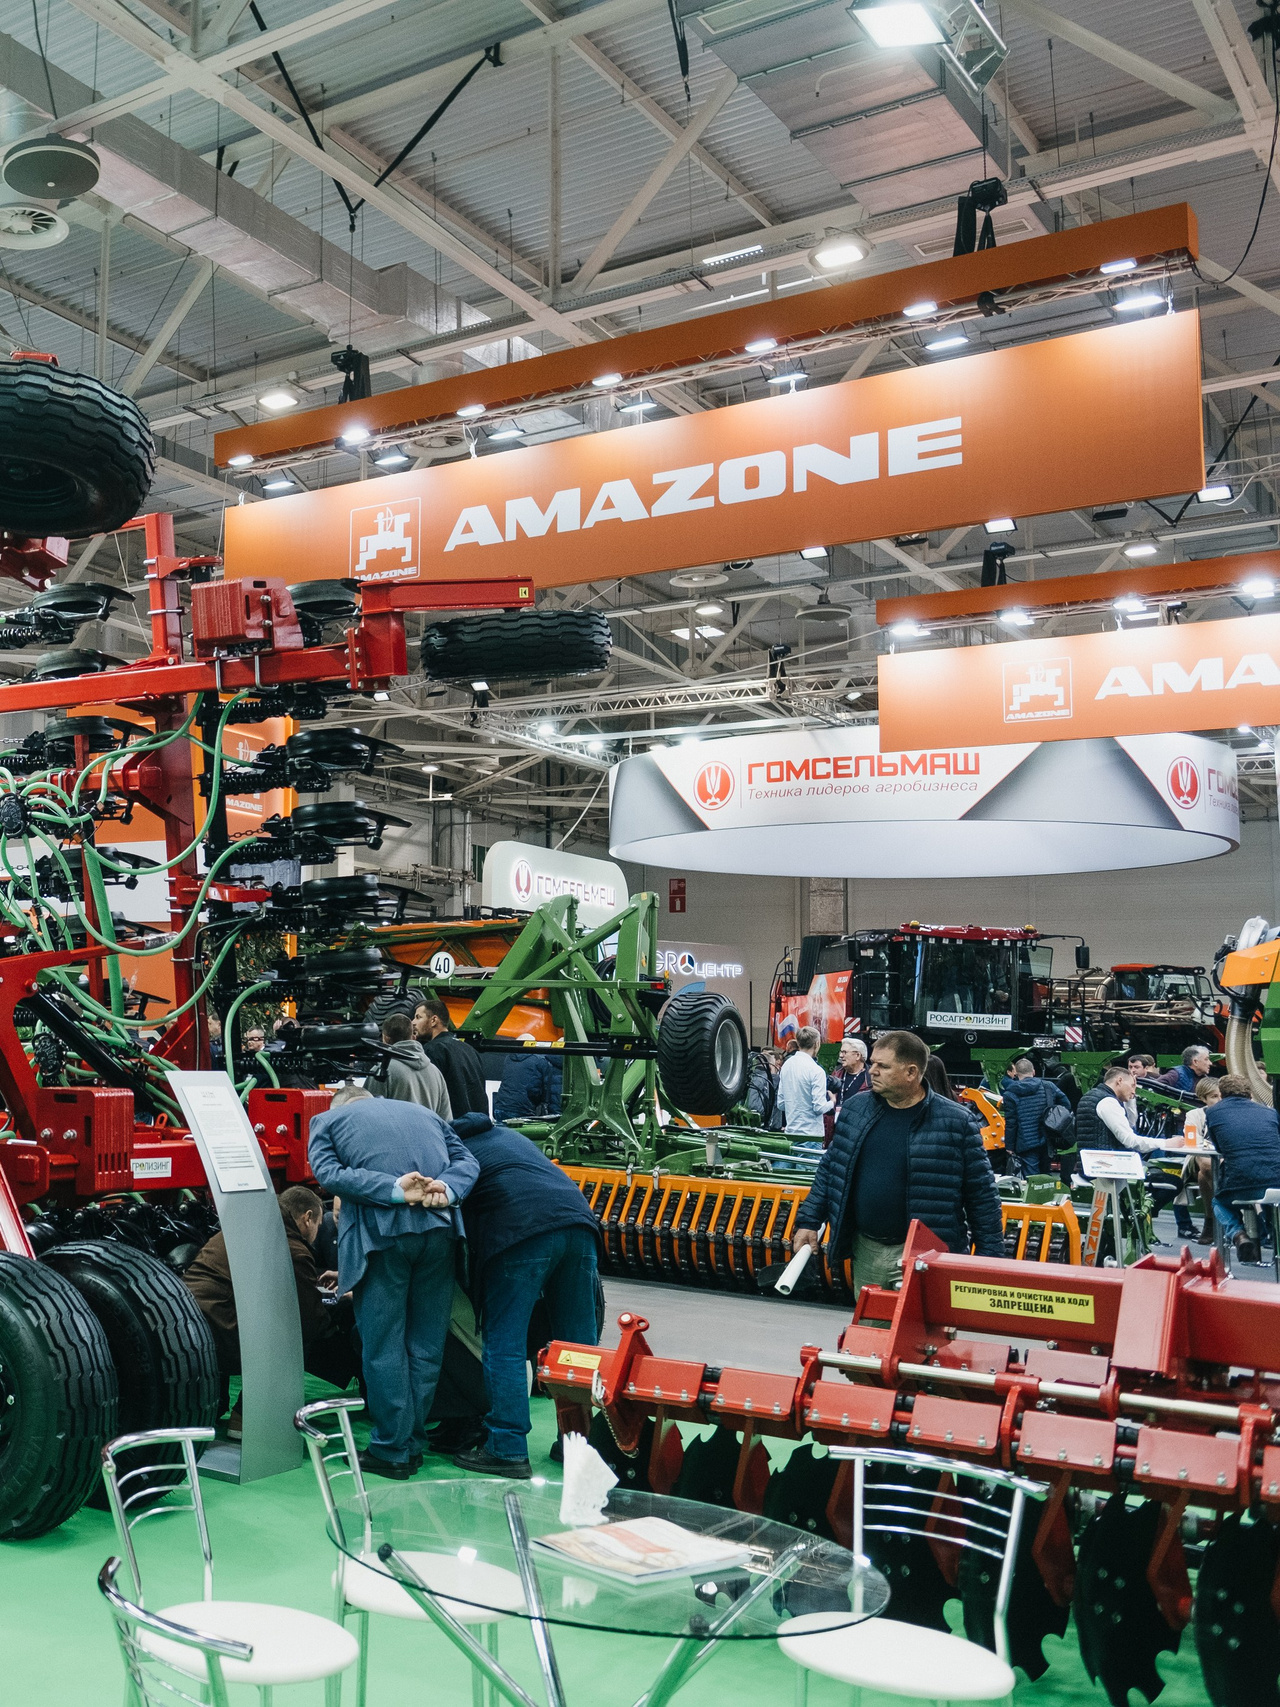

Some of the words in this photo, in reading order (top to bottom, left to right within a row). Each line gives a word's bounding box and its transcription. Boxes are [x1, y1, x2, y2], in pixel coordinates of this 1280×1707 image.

[443, 416, 963, 552] AMAZONE
[1094, 653, 1280, 700] AMA
[1006, 709, 1070, 721] AMAZONE
[748, 752, 980, 785] ГОМСЕЛЬМАШ
[748, 786, 802, 800] Техника
[806, 783, 870, 797] лидеров
[875, 780, 978, 795] агробизнеса
[435, 957, 450, 974] 40
[954, 1284, 1008, 1298] РЕГУЛИРОВКА
[1016, 1291, 1053, 1303] ОЧИСТКА
[1055, 1296, 1066, 1304] НА
[1067, 1297, 1090, 1307] ХОДУ
[989, 1298, 1055, 1314] ЗАПРЕЩЕНА
